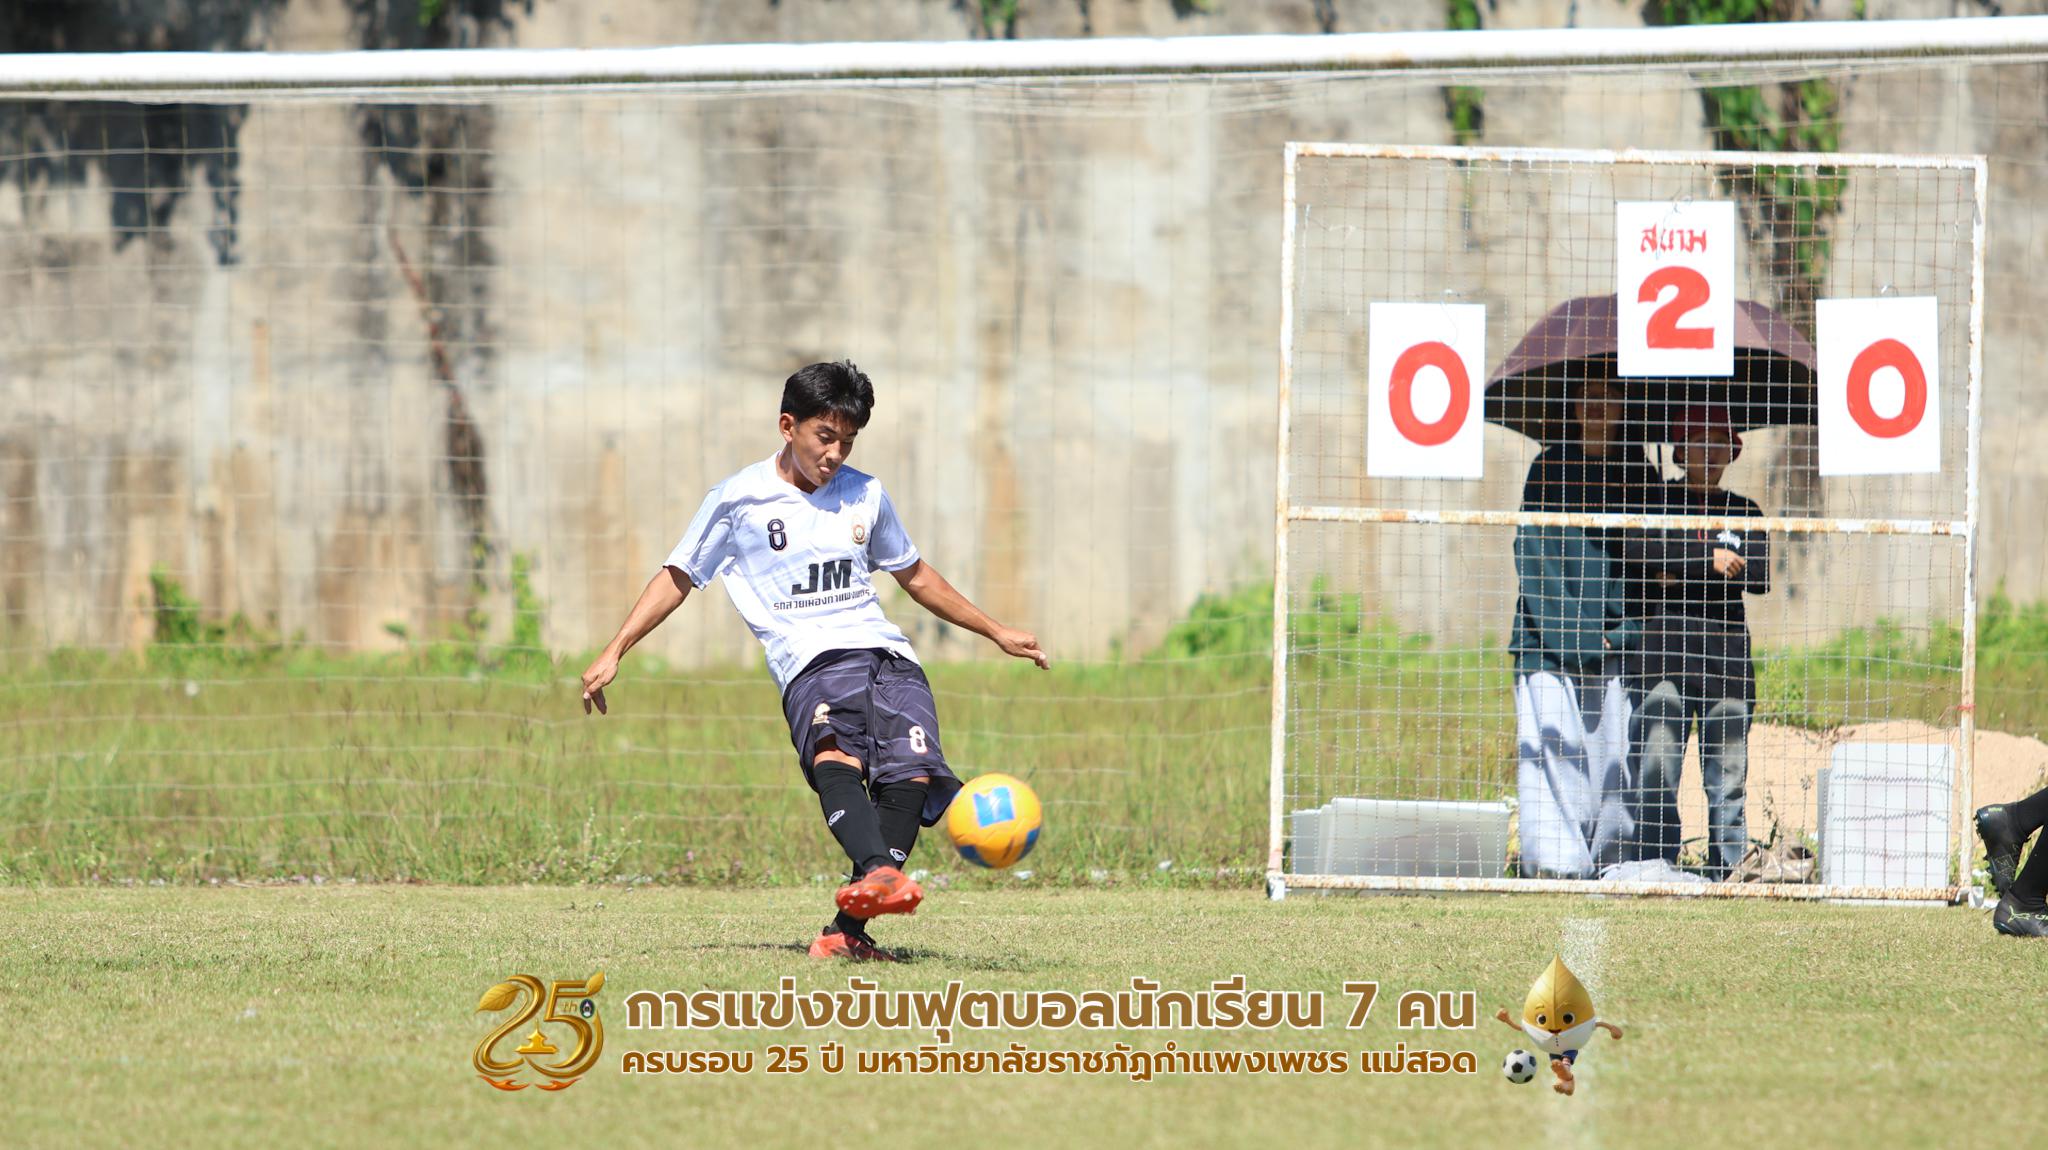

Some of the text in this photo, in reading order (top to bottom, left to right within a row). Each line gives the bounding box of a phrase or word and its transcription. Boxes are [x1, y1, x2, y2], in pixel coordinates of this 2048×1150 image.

[1640, 223, 1707, 253] สนาม
[1637, 266, 1714, 350] 2
[1388, 341, 1471, 447] 0
[1846, 338, 1927, 439] 0
[767, 518, 787, 551] 8
[791, 559, 852, 596] JM
[908, 725, 928, 754] 8
